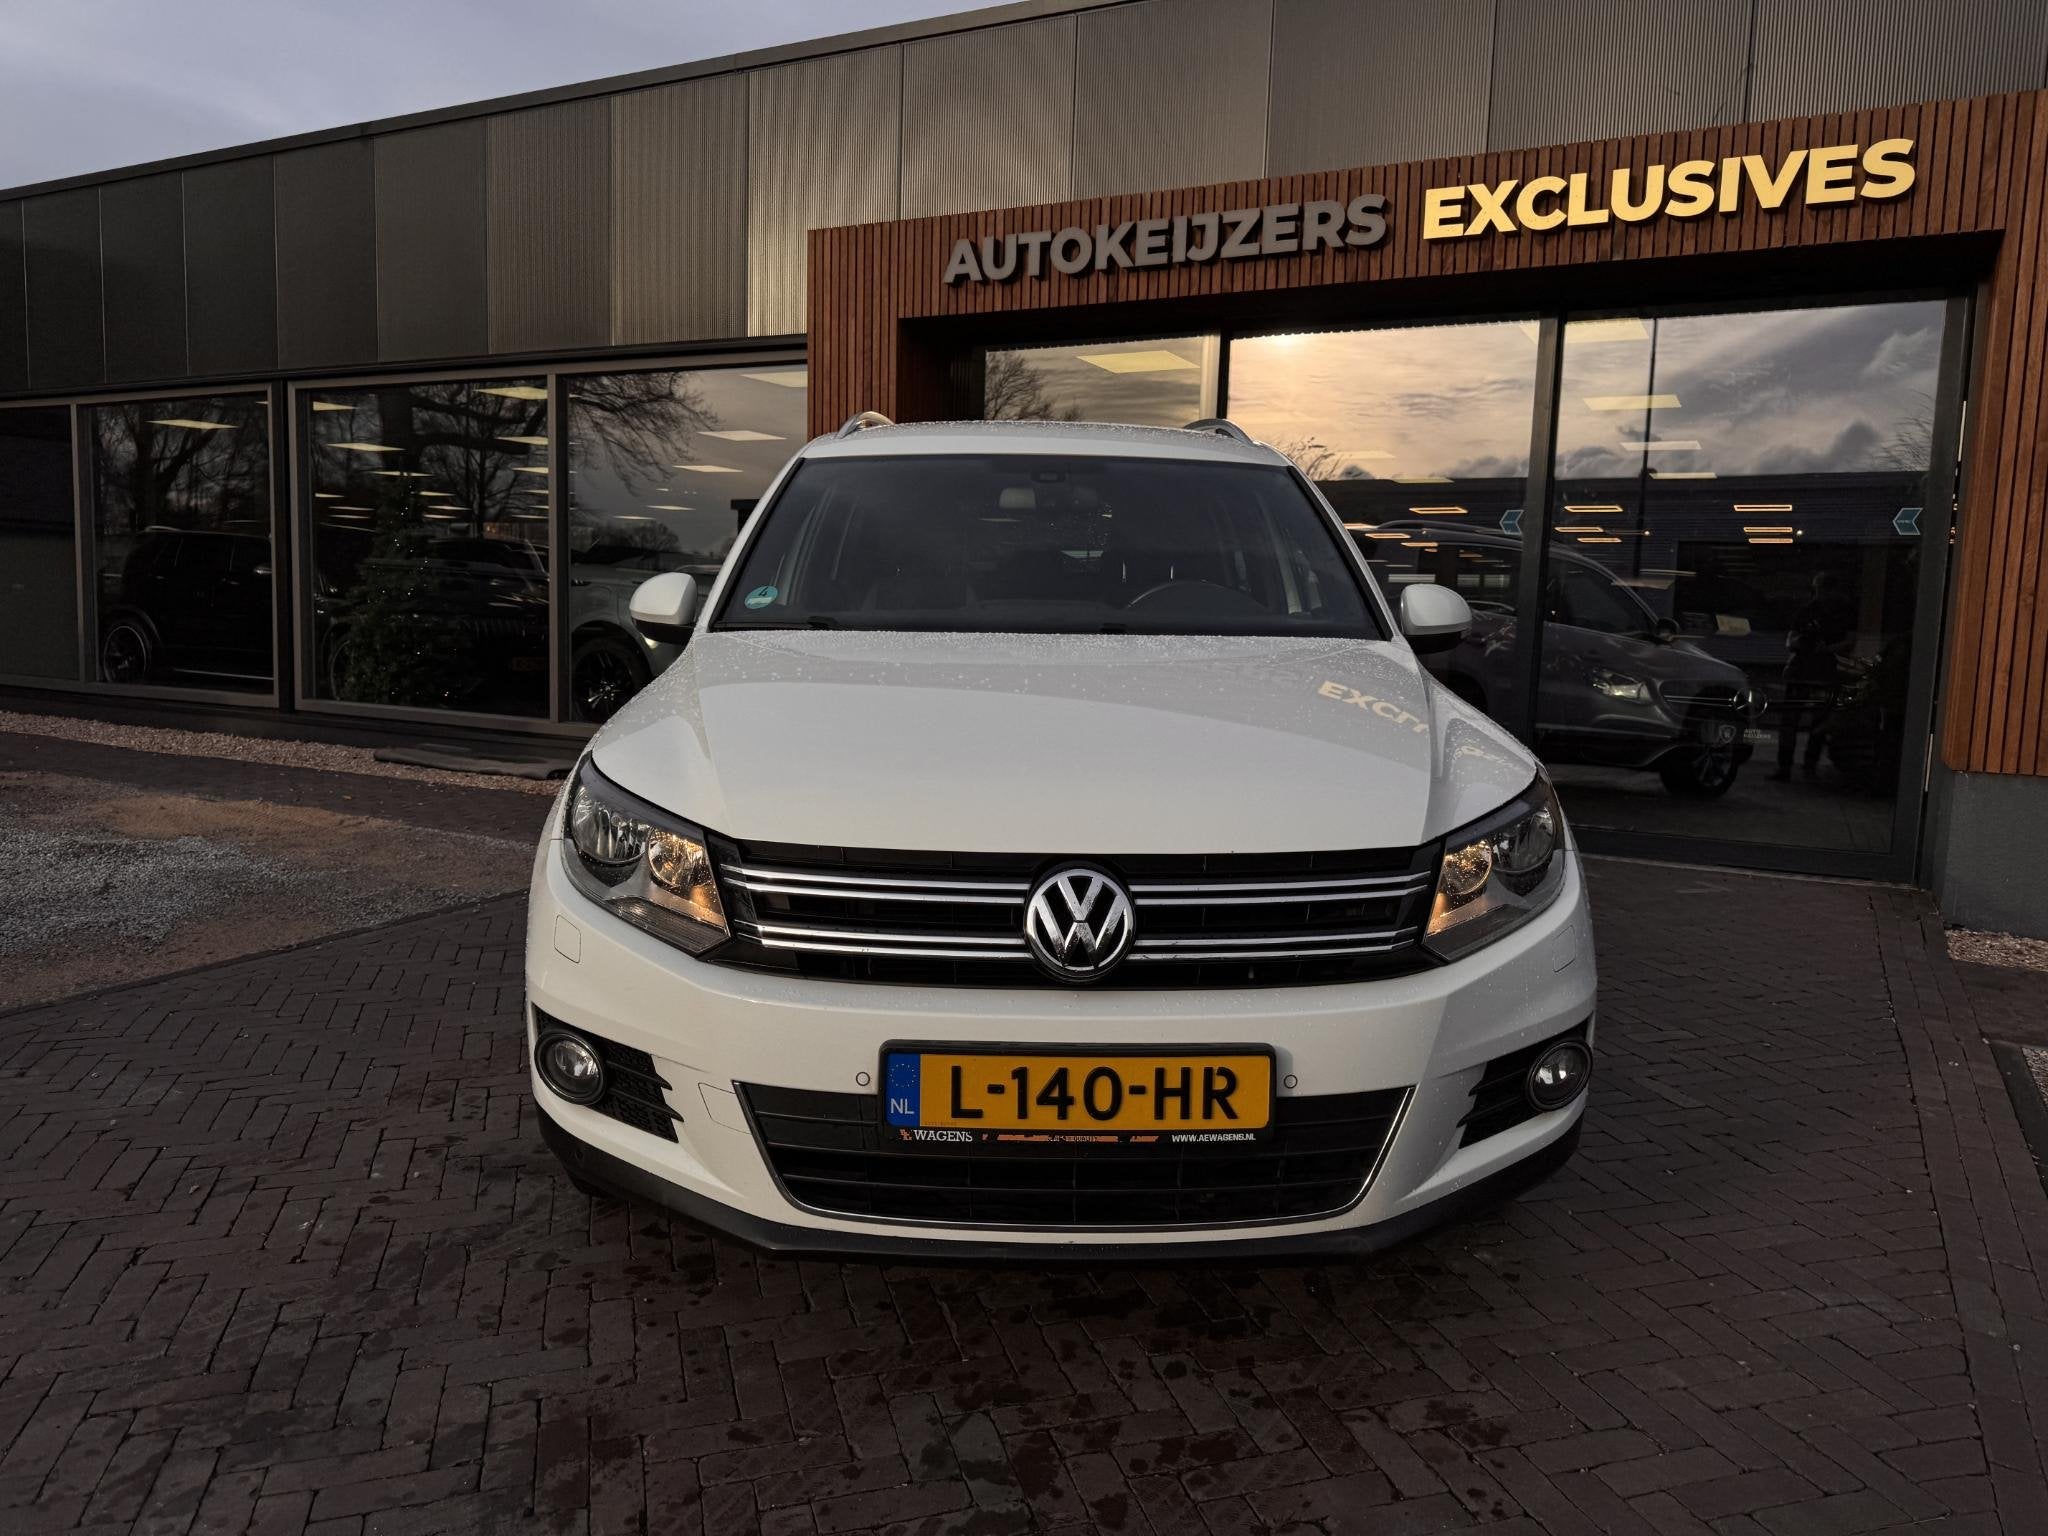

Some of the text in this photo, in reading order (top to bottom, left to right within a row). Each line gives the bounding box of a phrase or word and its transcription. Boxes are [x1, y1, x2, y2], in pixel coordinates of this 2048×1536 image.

[943, 138, 1917, 285] AUTOKEIJZERS EXCLUSIVES
[890, 1098, 915, 1115] NL
[950, 1065, 1239, 1121] L-140-HR
[913, 1129, 973, 1142] WAGENS
[1171, 1133, 1257, 1143] WWW.AEWAGENS.NL
